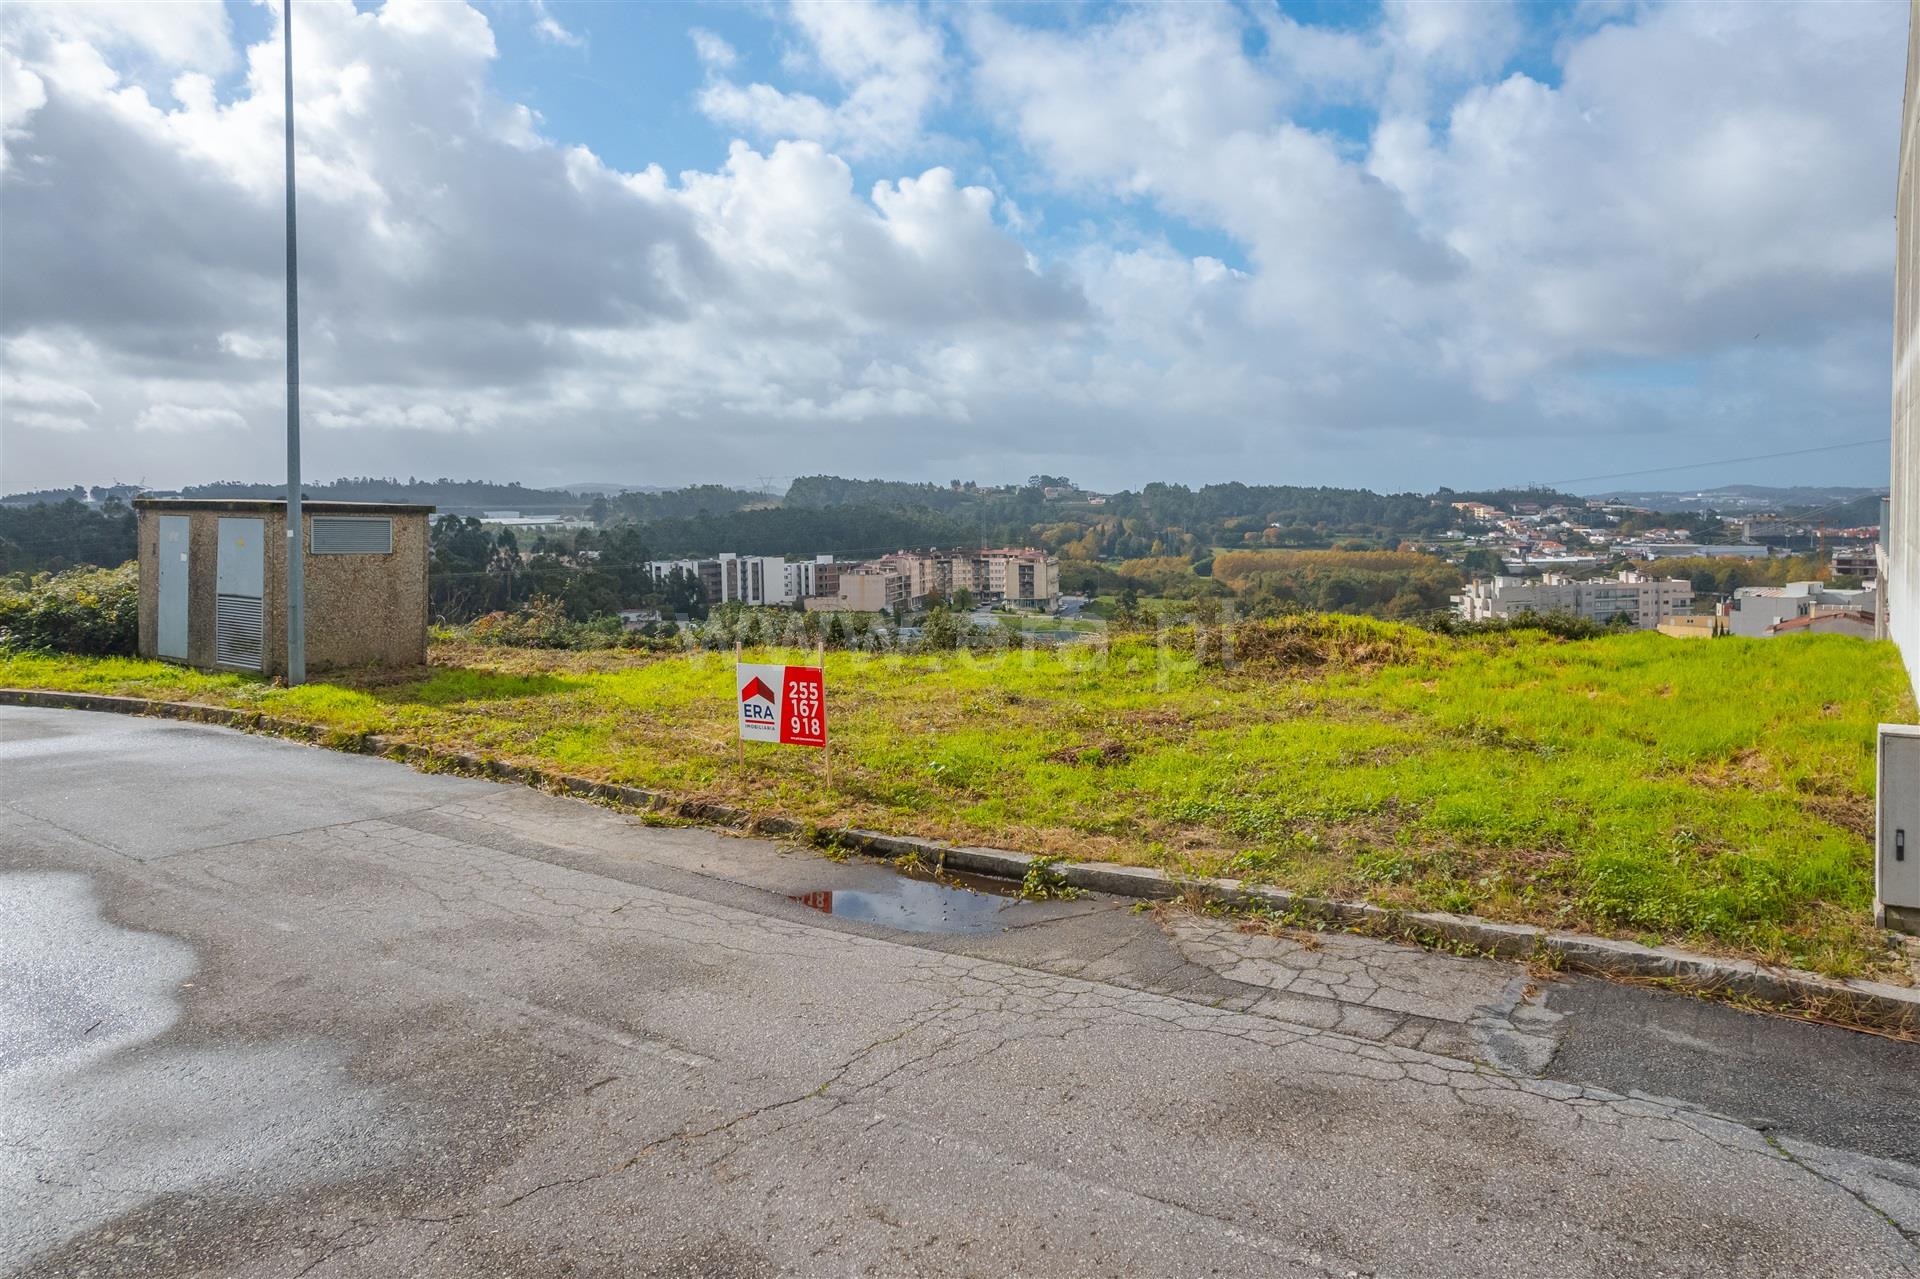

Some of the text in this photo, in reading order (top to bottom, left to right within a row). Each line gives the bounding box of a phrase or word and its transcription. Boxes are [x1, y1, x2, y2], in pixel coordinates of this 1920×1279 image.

[789, 681, 818, 699] 255
[744, 703, 774, 719] ERA
[791, 699, 819, 717] 167
[791, 716, 820, 735] 918
